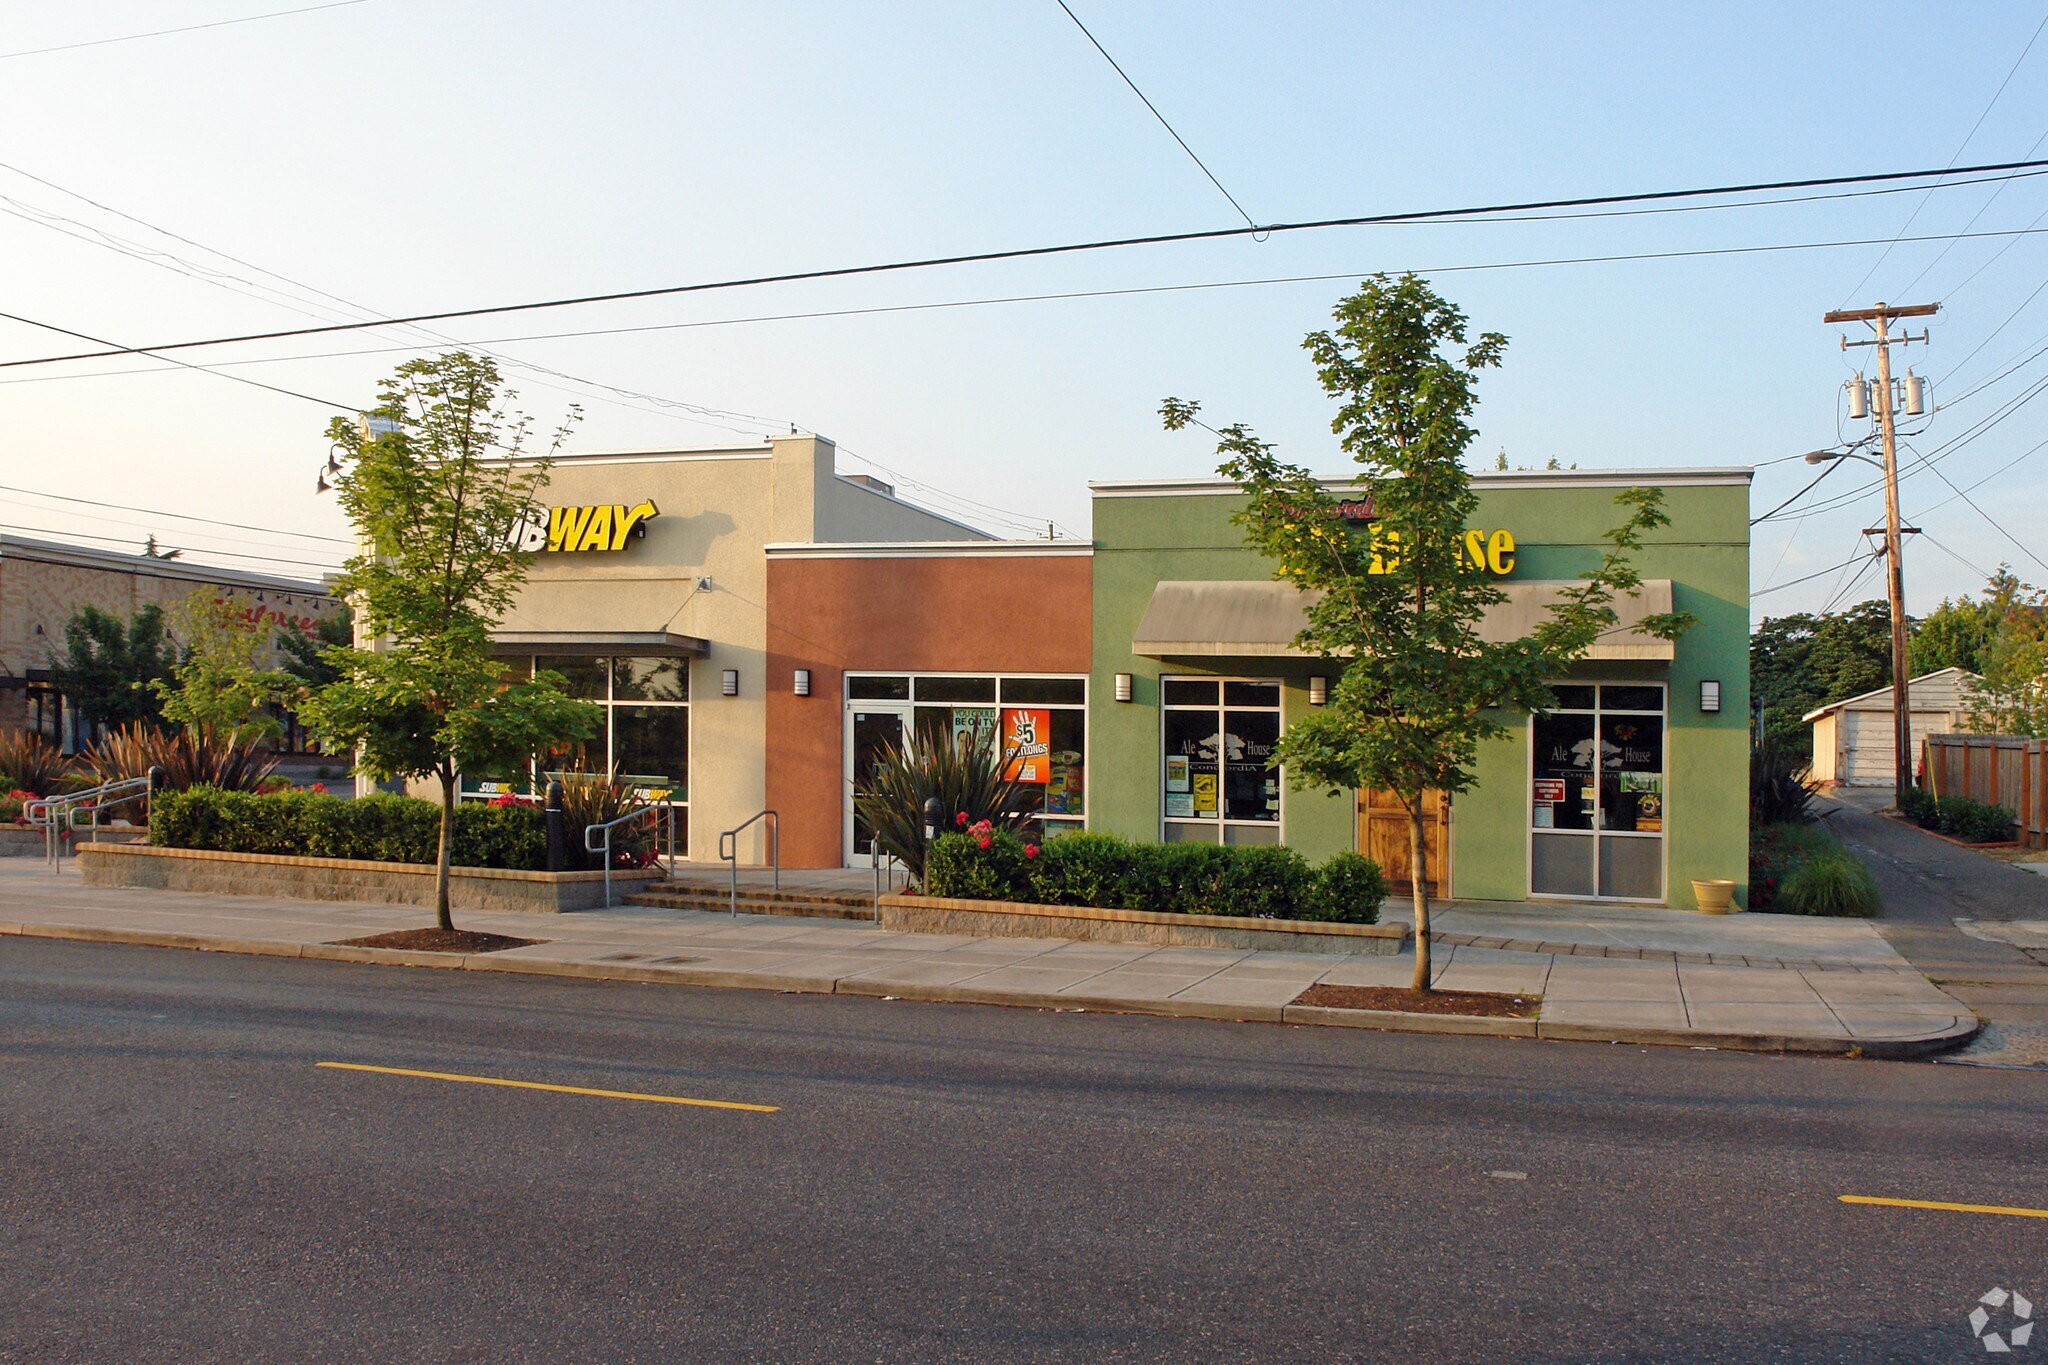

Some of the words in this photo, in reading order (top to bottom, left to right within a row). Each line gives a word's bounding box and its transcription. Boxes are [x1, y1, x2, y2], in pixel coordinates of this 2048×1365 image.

[955, 718, 966, 726] BE
[1017, 723, 1034, 743] $5
[1181, 739, 1197, 754] Ale
[1247, 740, 1271, 756] House
[1551, 745, 1568, 761] Ale
[1625, 747, 1651, 763] House
